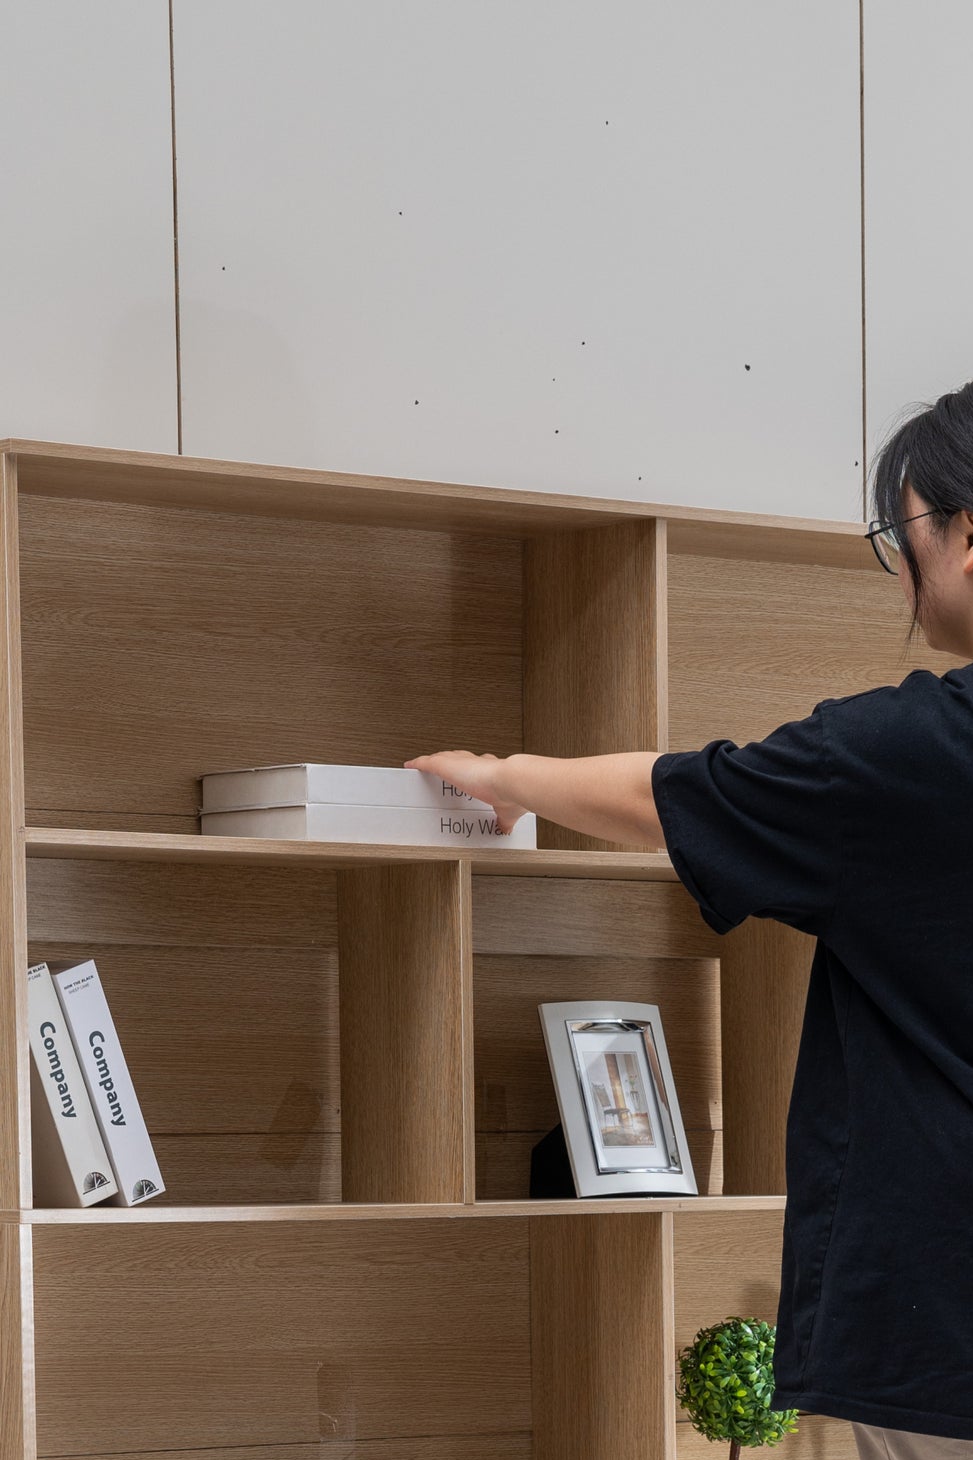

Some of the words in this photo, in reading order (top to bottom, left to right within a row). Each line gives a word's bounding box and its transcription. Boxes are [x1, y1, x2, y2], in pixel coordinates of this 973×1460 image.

[442, 780, 473, 801] Ho
[440, 817, 474, 838] Holy
[478, 818, 511, 836] Wa
[40, 1021, 77, 1119] Company
[89, 1031, 126, 1127] Company
